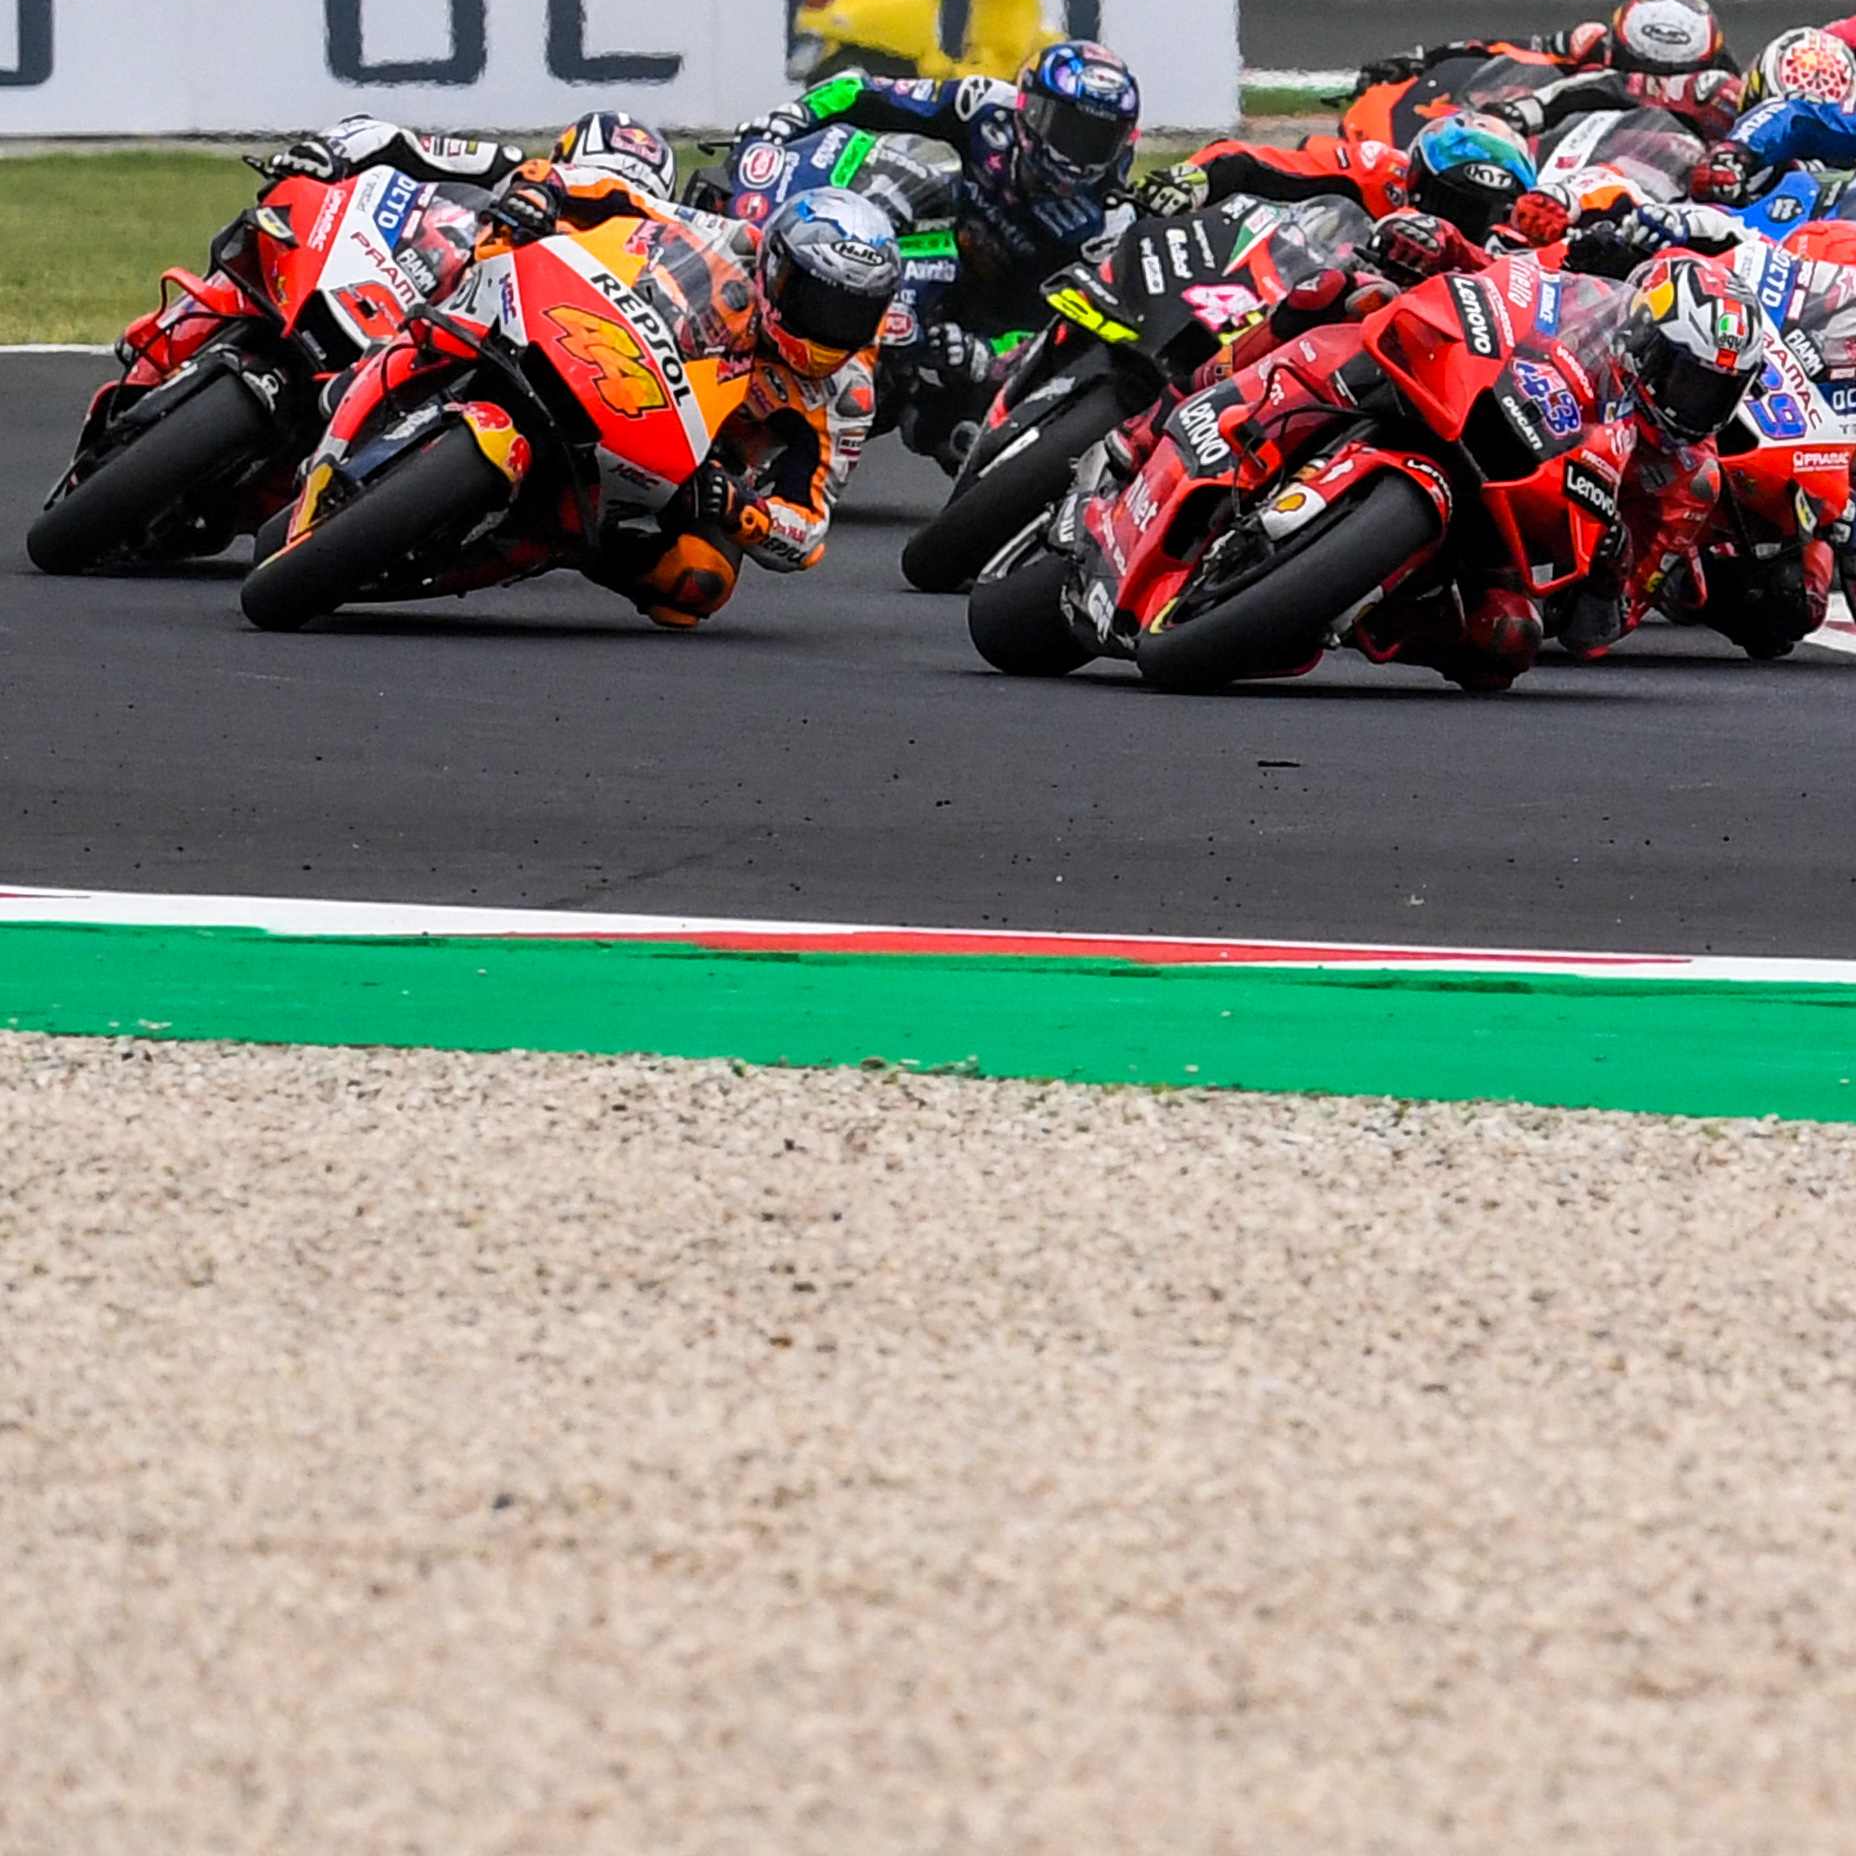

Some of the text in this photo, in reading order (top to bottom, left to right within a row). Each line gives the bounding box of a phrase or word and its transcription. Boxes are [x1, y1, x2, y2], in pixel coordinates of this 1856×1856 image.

[1465, 165, 1512, 189] KYT
[350, 230, 418, 305] PRAM
[590, 272, 690, 407] REPSOL
[1453, 276, 1493, 354] Lenovo
[1763, 331, 1823, 430] RAMAC
[1178, 389, 1231, 466] Lenovo
[1502, 395, 1543, 451] DUCATI
[1566, 465, 1616, 517] Lenovo
